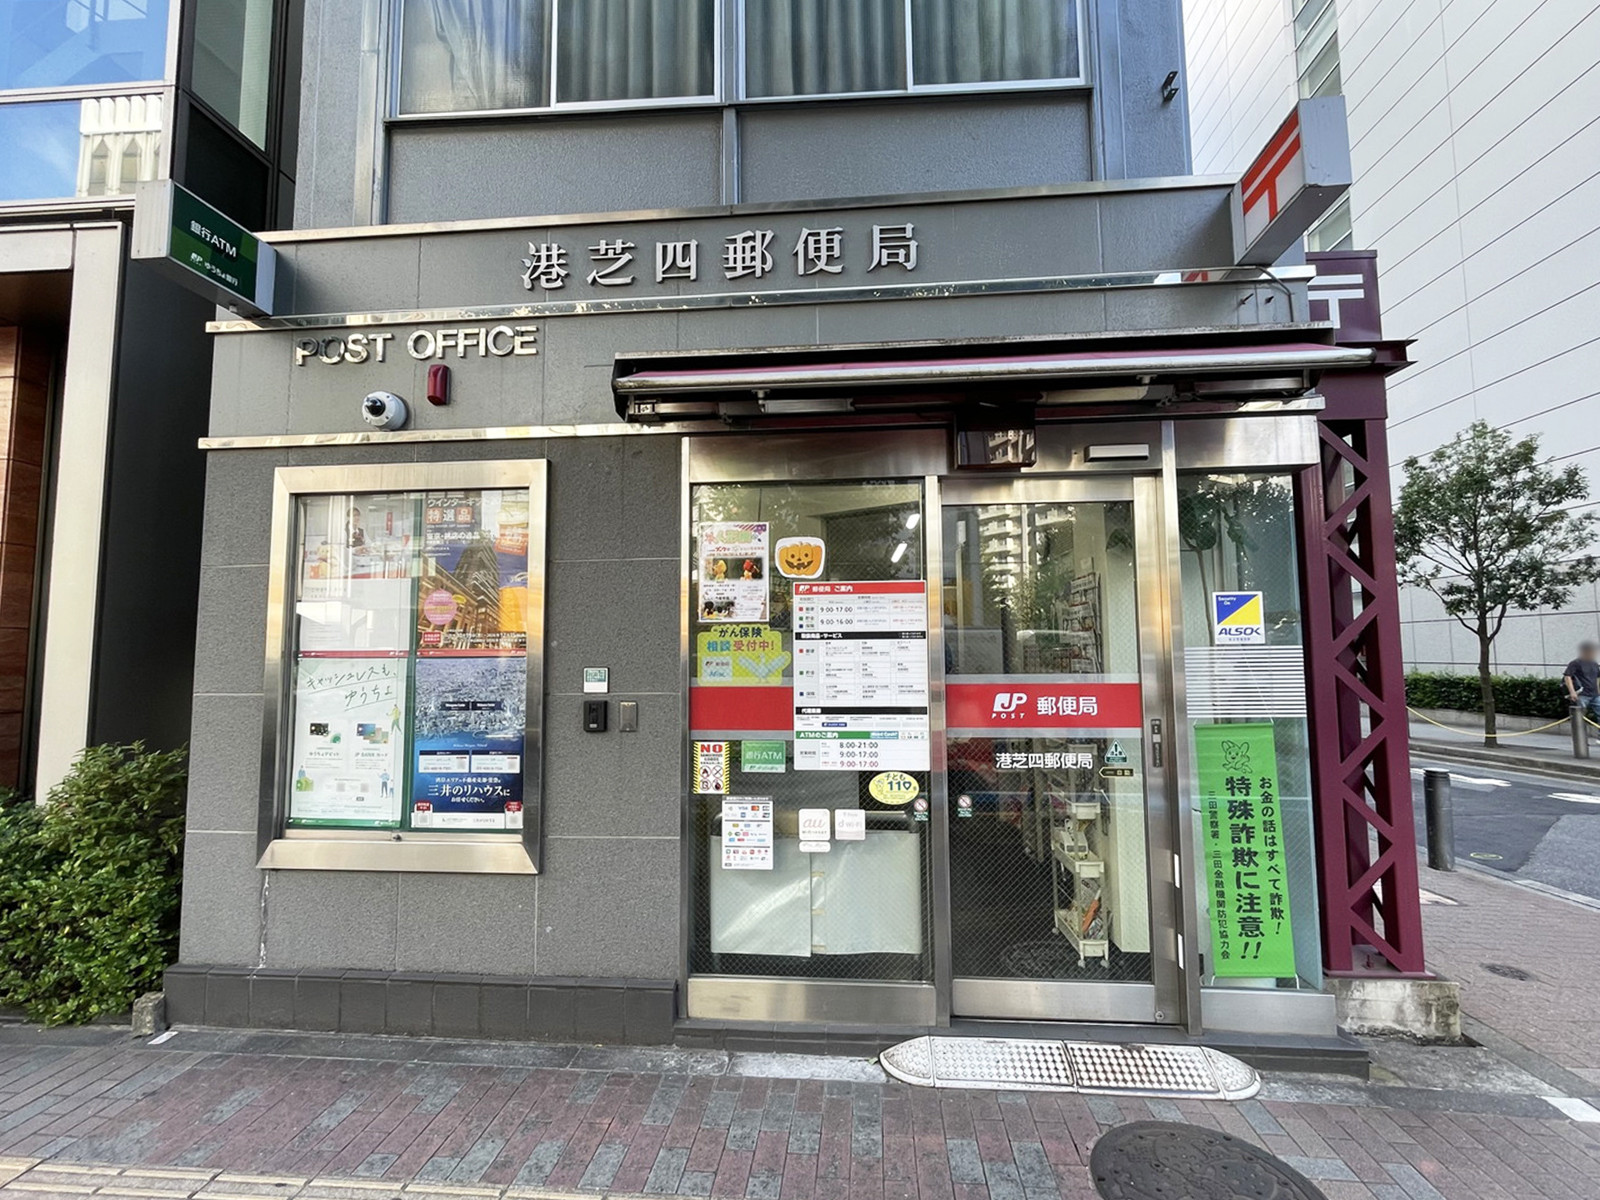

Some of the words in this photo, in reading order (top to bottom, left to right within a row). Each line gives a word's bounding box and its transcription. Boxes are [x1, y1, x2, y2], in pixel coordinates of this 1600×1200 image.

[190, 220, 237, 258] 銀行ATM
[520, 223, 920, 290] 港芝四郵便局
[295, 333, 394, 366] POST
[407, 325, 538, 360] OFFICE
[718, 627, 763, 639] がん保険
[1218, 627, 1261, 636] ALSOK
[306, 663, 397, 690] キャッシュレスも、
[345, 684, 393, 707] ゆうちょ
[1037, 696, 1098, 716] 郵便局
[700, 743, 723, 753] NO
[995, 752, 1093, 769] 港芝四郵便局
[427, 784, 511, 797] 三井のリハウスに
[802, 818, 825, 828] au
